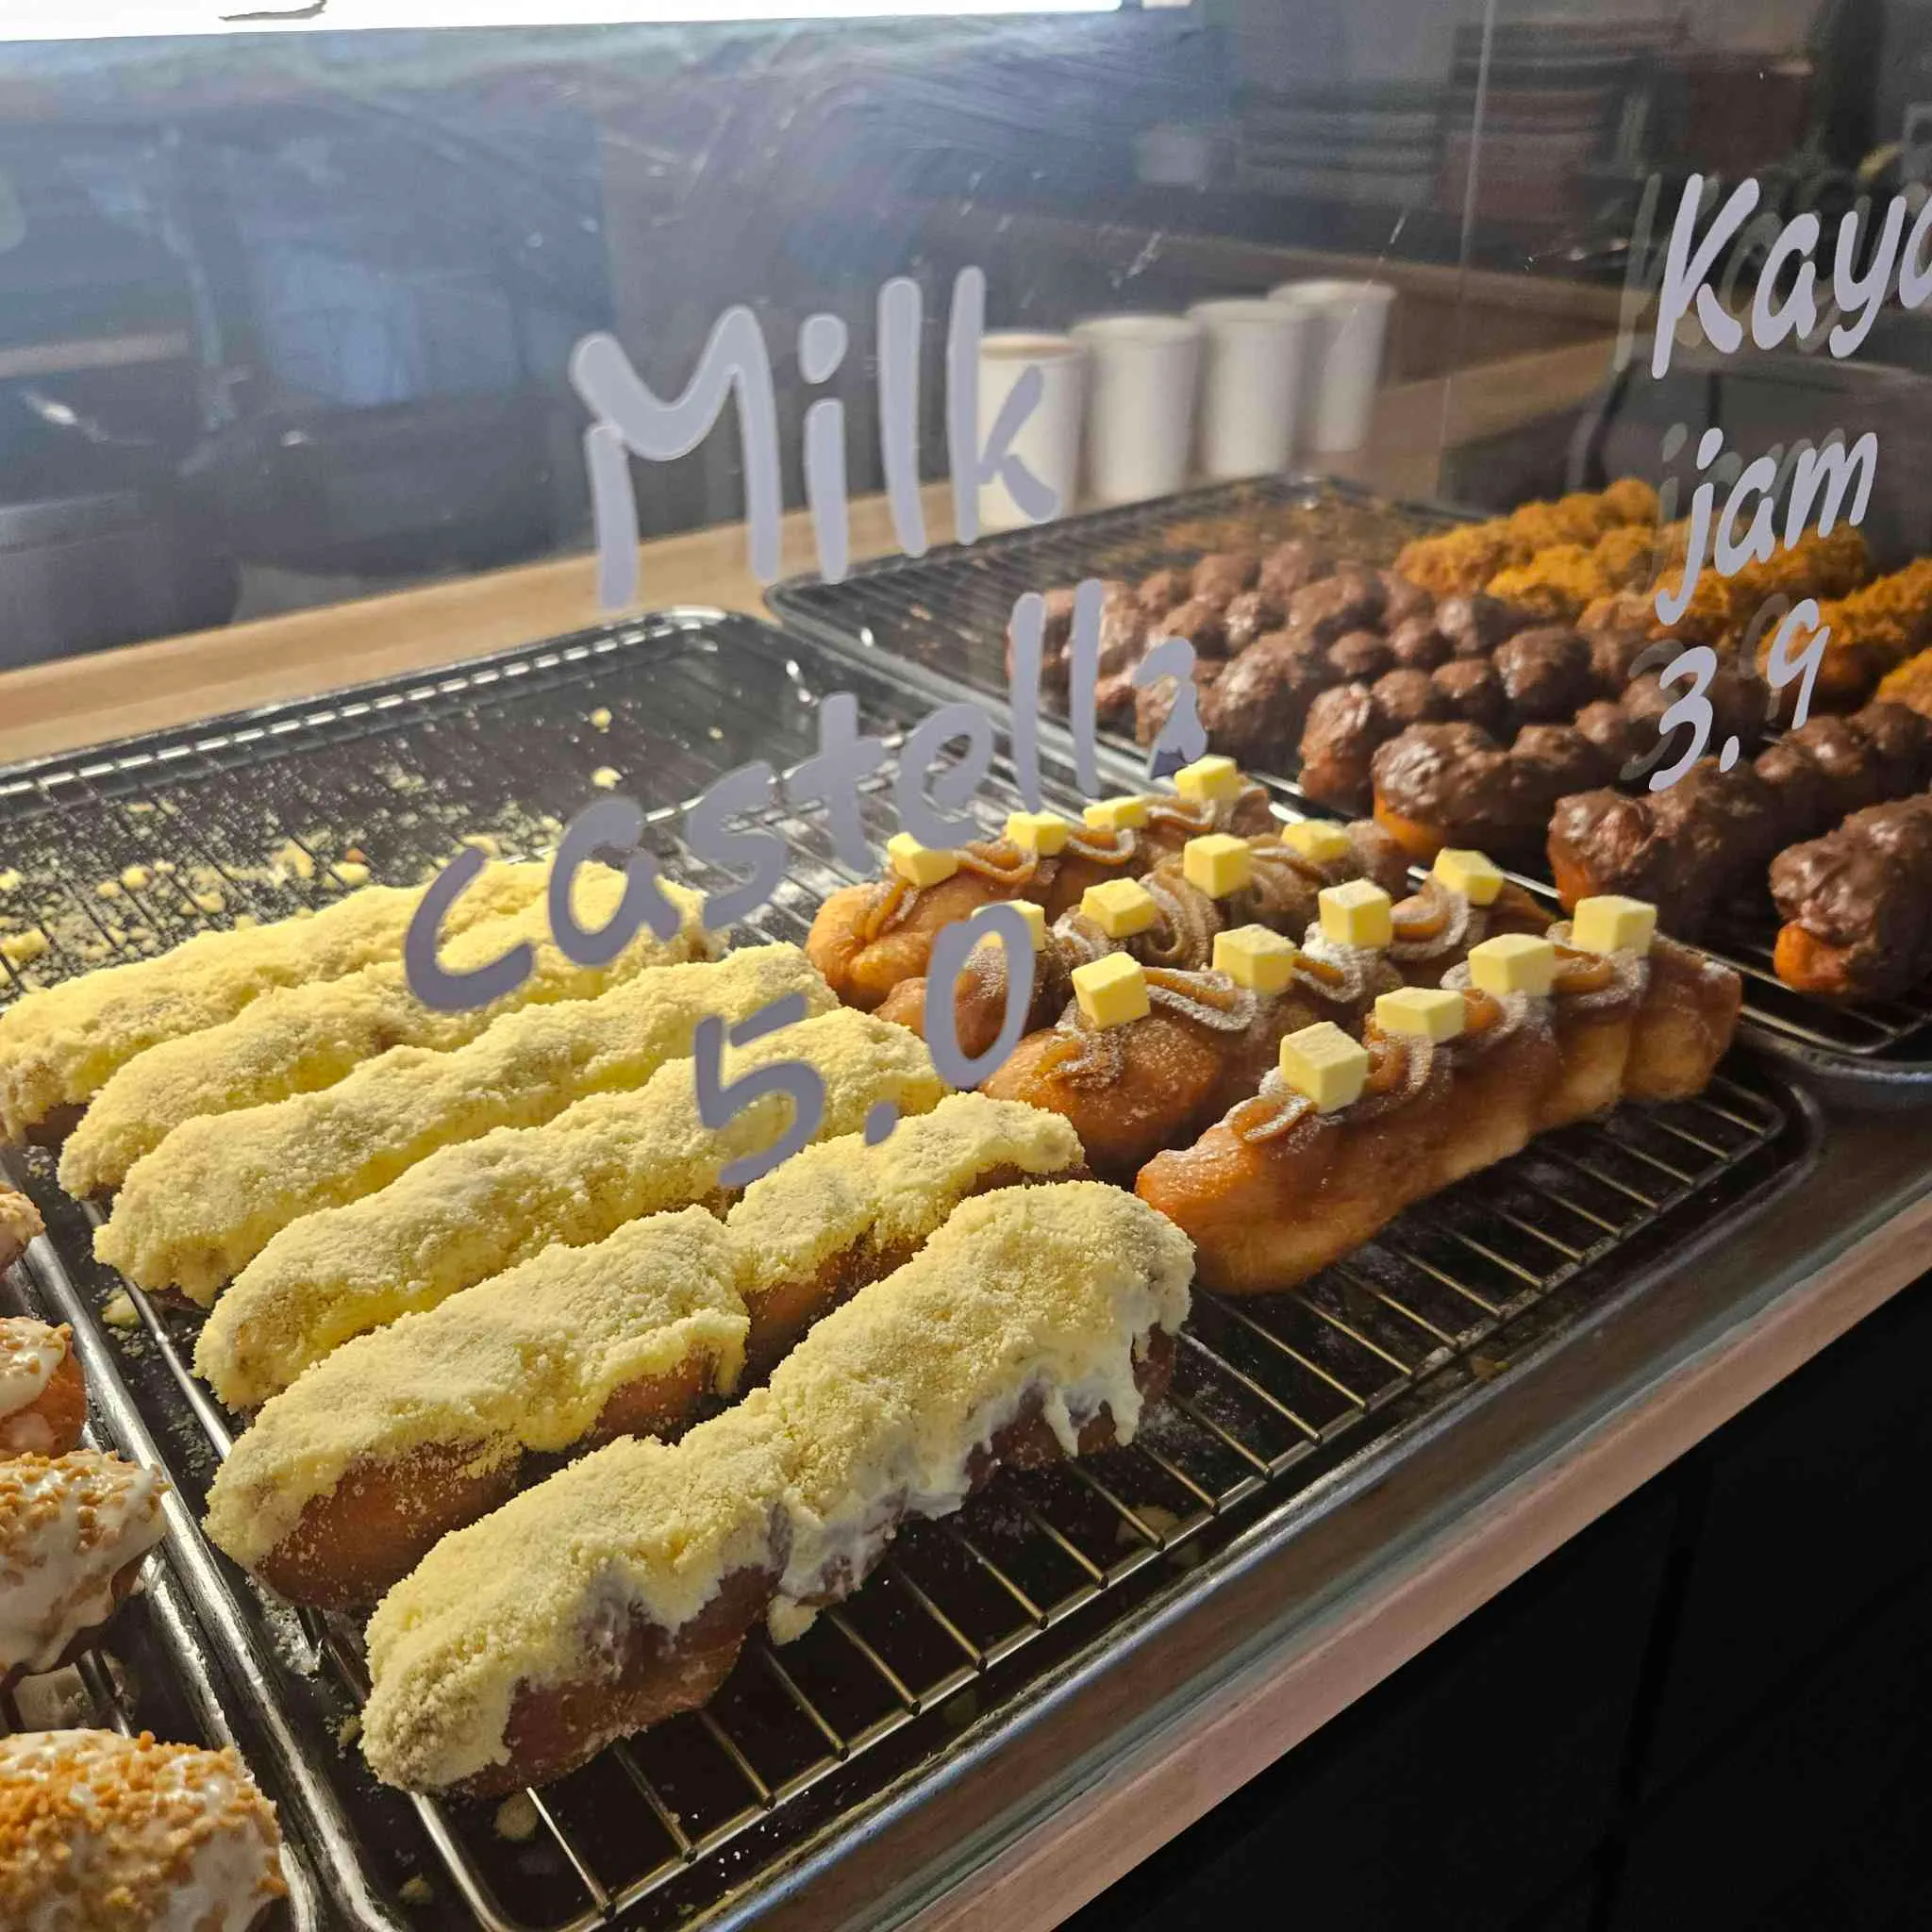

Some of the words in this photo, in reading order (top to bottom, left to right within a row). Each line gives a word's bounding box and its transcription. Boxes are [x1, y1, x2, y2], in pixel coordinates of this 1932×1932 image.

[568, 266, 1060, 611] Milk
[1655, 427, 1878, 626] jam
[1649, 598, 1830, 791] 3.9
[693, 901, 1034, 1188] 5.0
